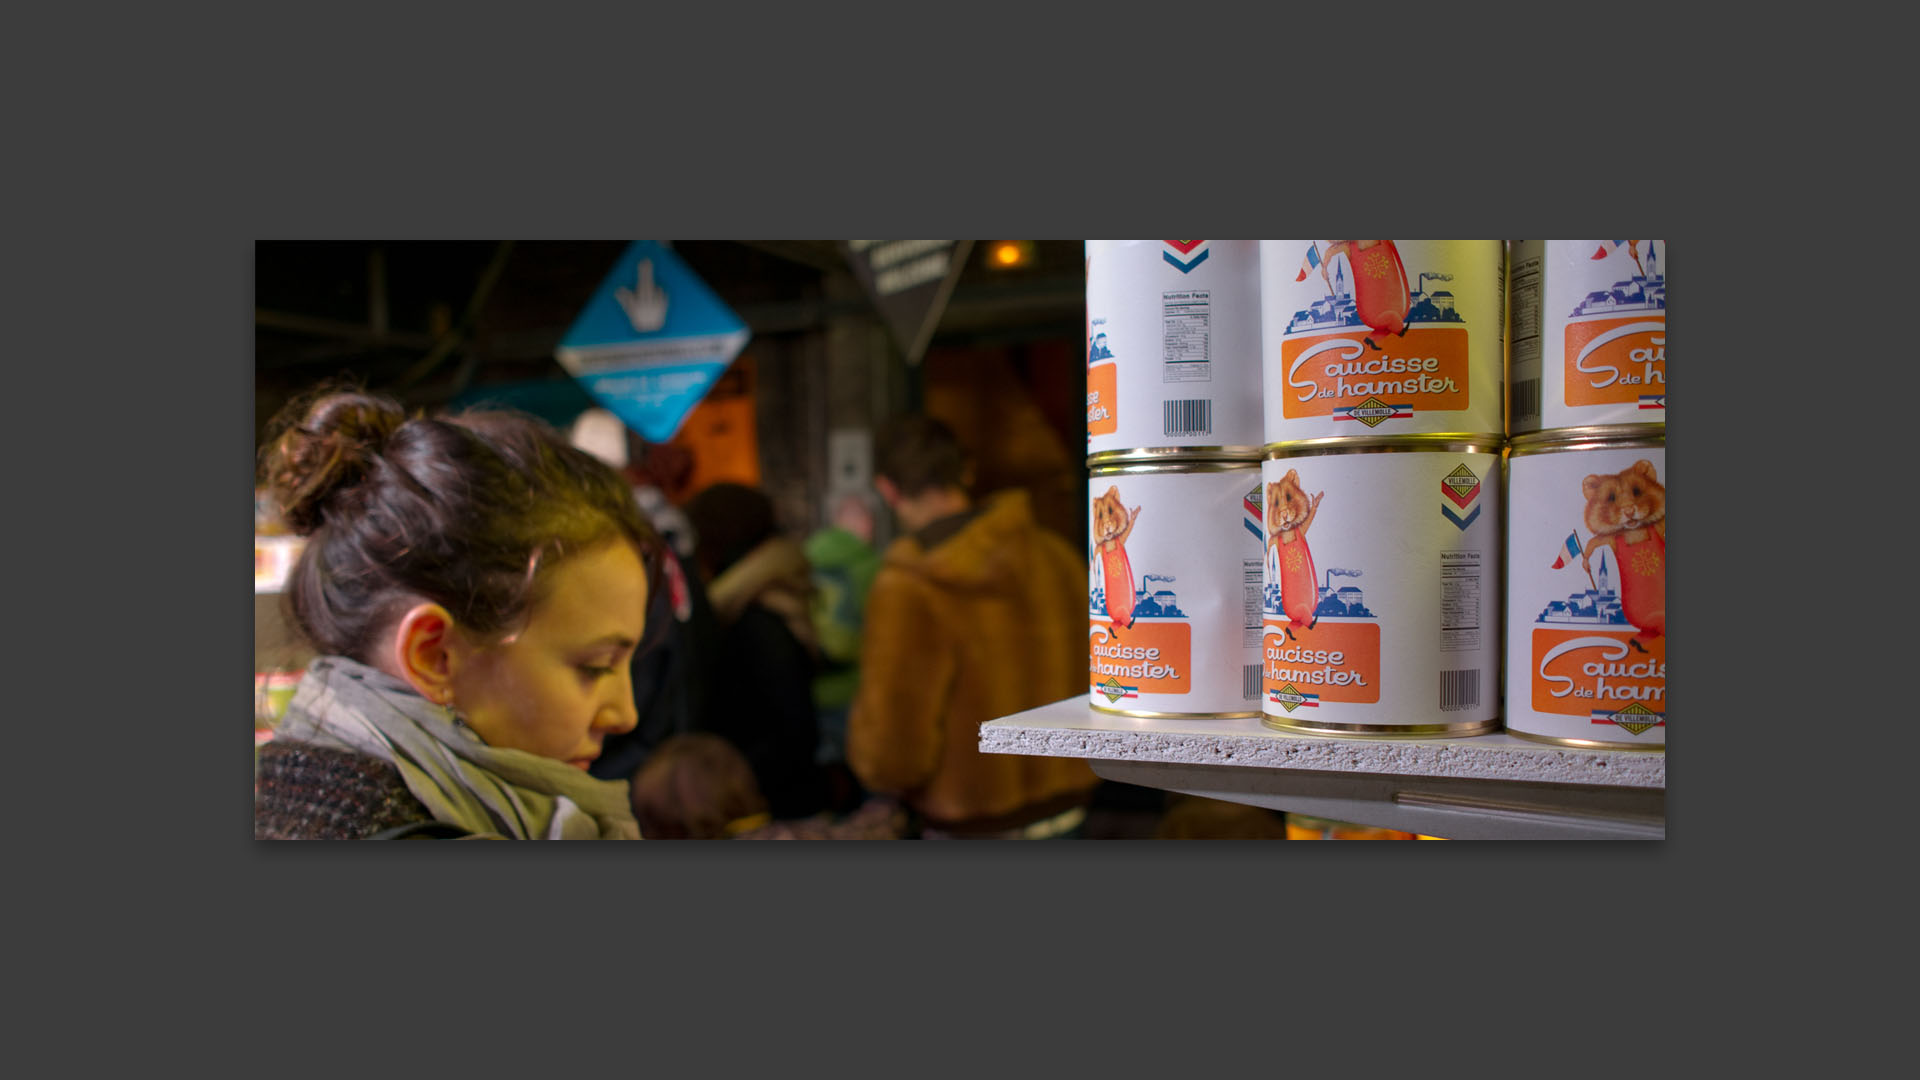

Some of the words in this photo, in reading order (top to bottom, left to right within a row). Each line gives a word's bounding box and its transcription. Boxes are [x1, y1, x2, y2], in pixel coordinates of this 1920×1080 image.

[1288, 338, 1439, 402] Saucisse
[1619, 372, 1641, 385] de
[1318, 387, 1335, 399] de
[1337, 373, 1460, 398] hamster
[1361, 408, 1392, 416] VILLEMOLLE
[1447, 477, 1476, 485] VILLEMOLLE
[1097, 657, 1180, 679] hamster
[1271, 660, 1368, 686] hamster
[1573, 687, 1594, 698] de
